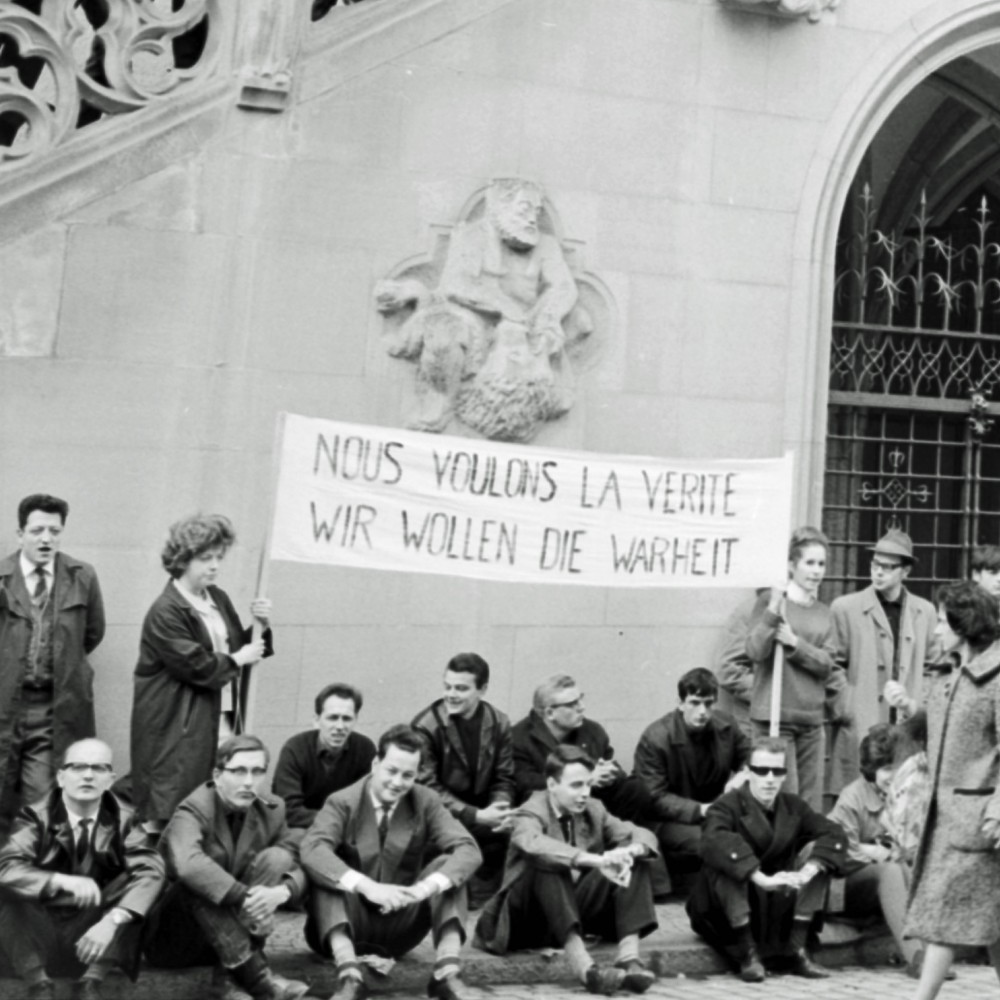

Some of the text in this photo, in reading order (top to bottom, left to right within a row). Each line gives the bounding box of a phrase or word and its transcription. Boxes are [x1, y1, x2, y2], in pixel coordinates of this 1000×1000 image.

[313, 433, 738, 517] NOUS VOULONS LA VERITE
[309, 501, 739, 577] WIR WOLLEN DIE WARHEIT
